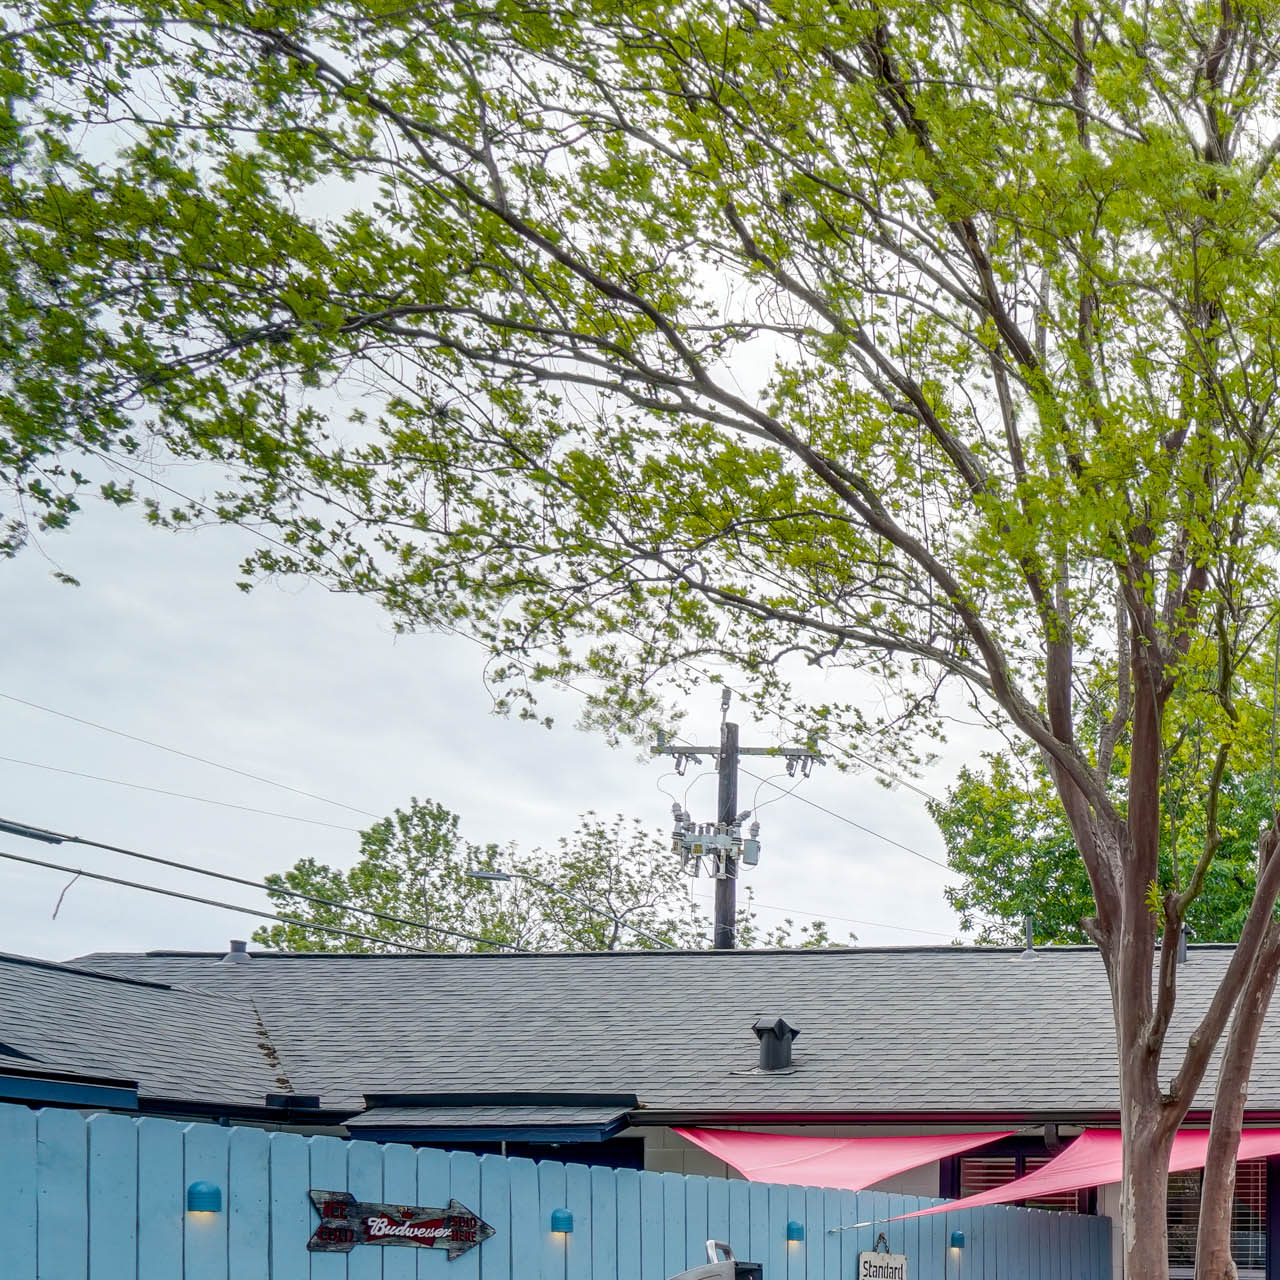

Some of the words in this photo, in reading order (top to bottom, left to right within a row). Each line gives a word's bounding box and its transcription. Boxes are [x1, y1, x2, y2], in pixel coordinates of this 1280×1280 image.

[322, 1201, 347, 1219] ICE
[317, 1226, 353, 1242] COLD
[367, 1217, 452, 1238] Budweiser
[863, 1260, 903, 1280] Standard
